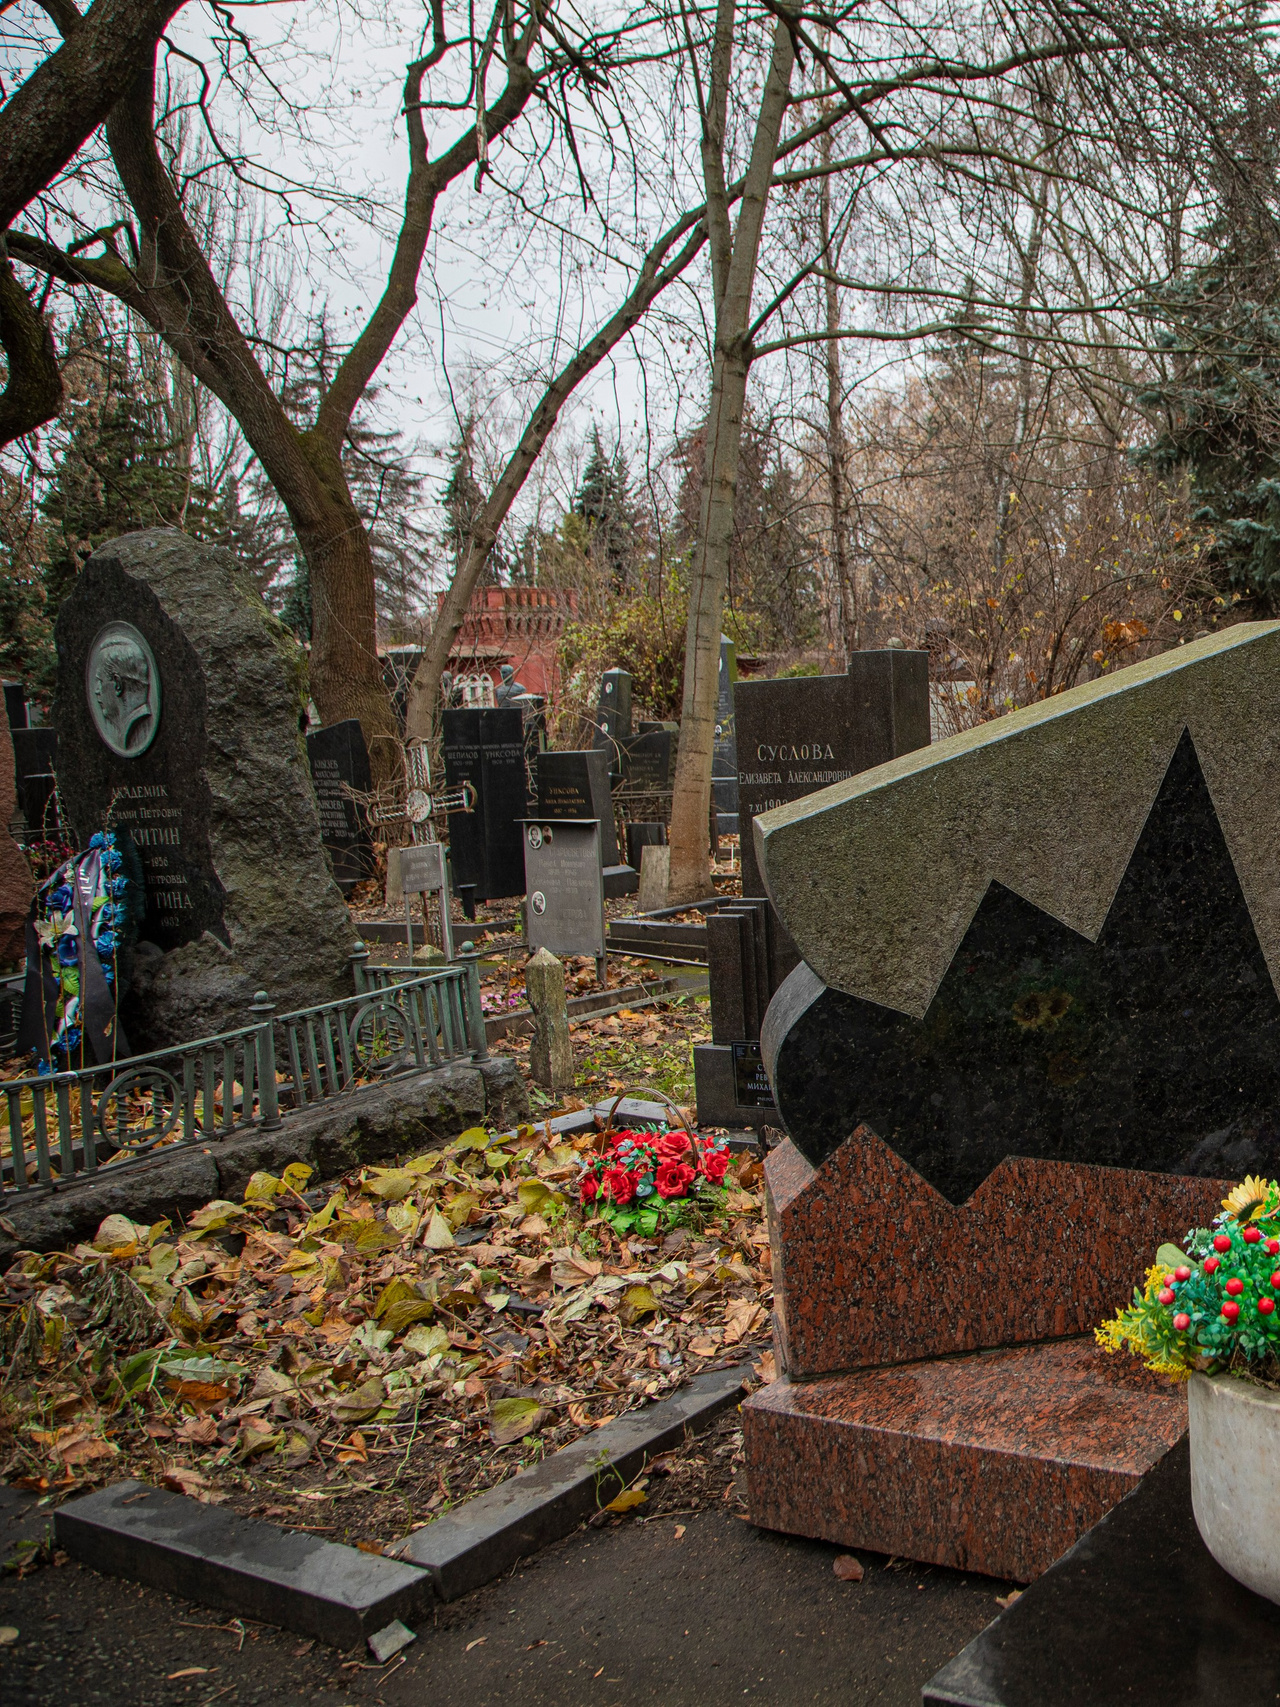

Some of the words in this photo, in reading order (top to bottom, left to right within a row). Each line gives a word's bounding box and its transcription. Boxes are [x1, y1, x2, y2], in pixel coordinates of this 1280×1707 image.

[757, 743, 836, 762] СУСЛОВА
[738, 771, 783, 785] ЕЛИЗАВЕТА
[787, 769, 853, 784] АЛЕКСАНДРОВНА
[111, 784, 169, 800] АКАДЕМИК
[129, 826, 181, 847] КИТИН
